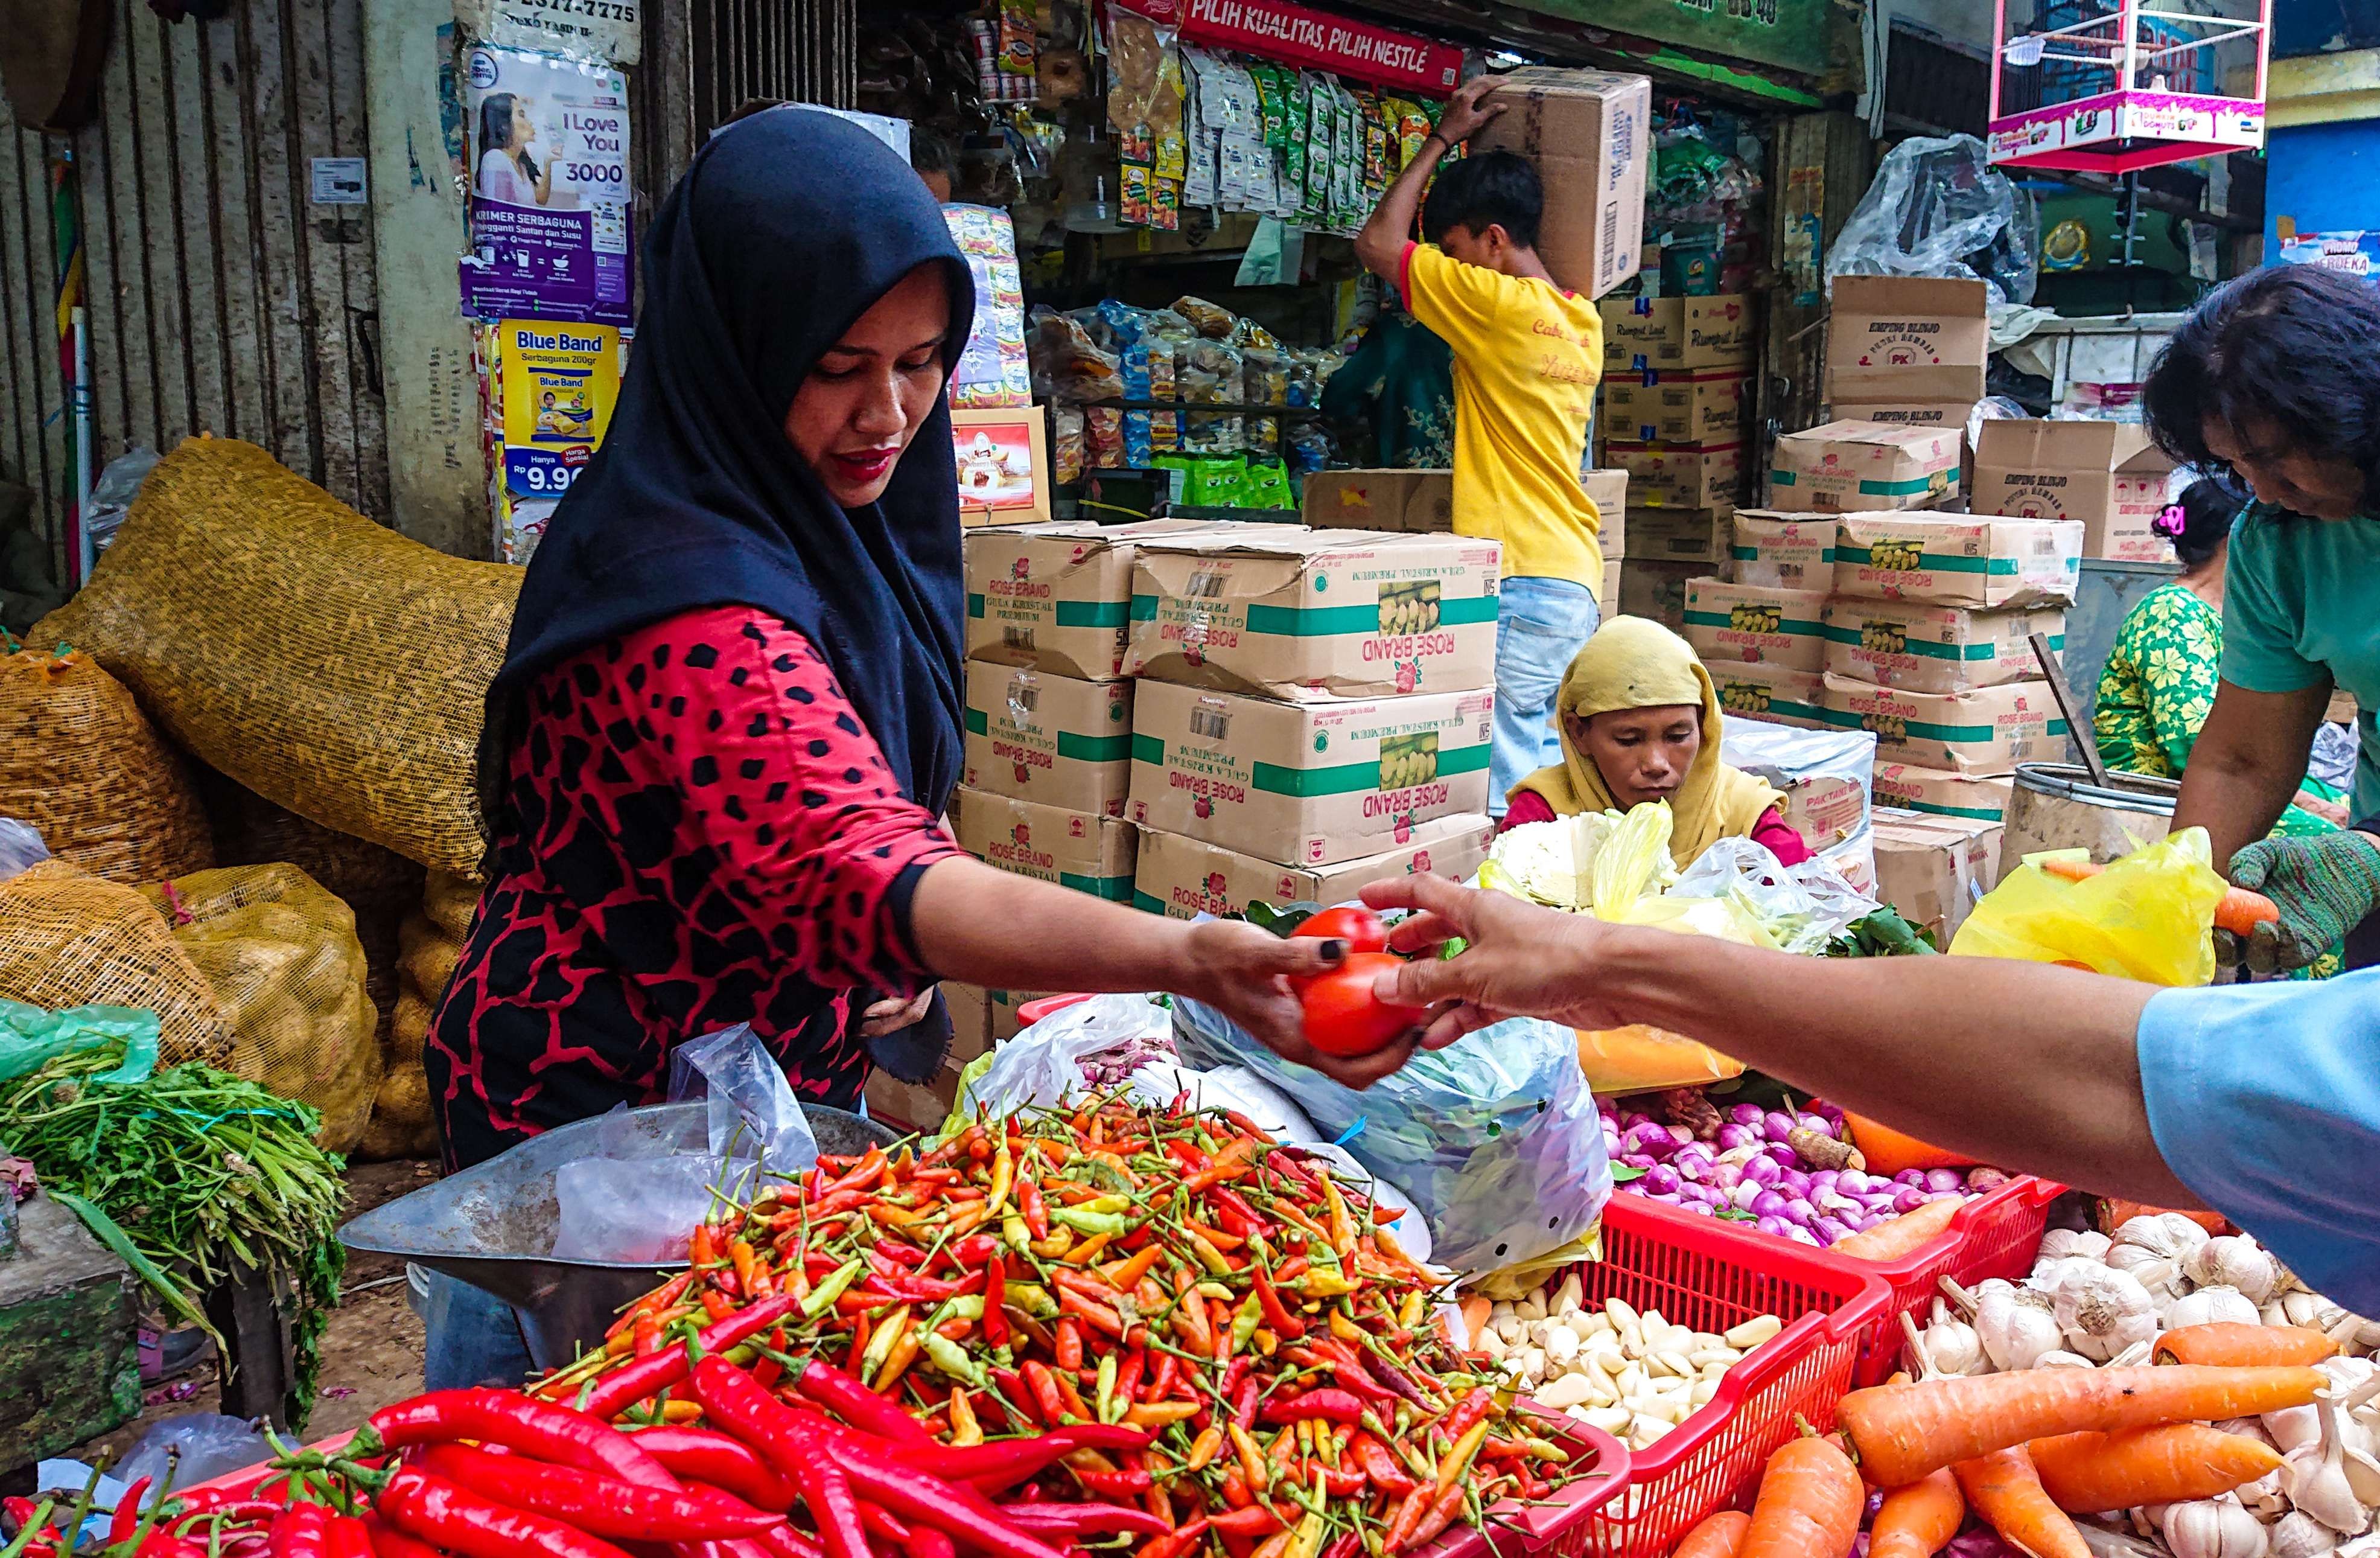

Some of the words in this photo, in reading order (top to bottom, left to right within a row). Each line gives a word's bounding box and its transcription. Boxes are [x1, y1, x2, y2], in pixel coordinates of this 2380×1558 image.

[1191, 0, 1241, 28] PILIH
[1243, 5, 1325, 52] KUALITAS,
[1328, 27, 1372, 59] PILIH
[1372, 40, 1430, 73] NESTLÉ
[563, 113, 569, 130] I
[573, 113, 619, 132] Love
[582, 134, 619, 152] You
[566, 162, 622, 183] 3000
[476, 211, 514, 223] KRIMER
[517, 213, 582, 230] SERBAGUNA
[476, 223, 514, 232] ngganti
[516, 225, 542, 234] Santan
[545, 228, 560, 237] dan
[561, 230, 581, 240] Susu
[1869, 322, 1905, 333] EMPING
[518, 331, 556, 349] Blue
[559, 334, 602, 351] Band
[521, 353, 569, 364] Serbaguna
[572, 356, 596, 366] 200gr
[540, 377, 560, 386] Blue
[561, 378, 582, 387] Band
[1872, 411, 1909, 421] EMPING
[531, 456, 556, 465] Hanya
[565, 455, 589, 463] Spesial
[1859, 569, 1896, 583] BRAND
[1899, 572, 1932, 587] ROSE
[990, 580, 1014, 595] ROSE
[1015, 583, 1050, 598] BRAND
[1416, 633, 1455, 656] ROSE
[1717, 631, 1755, 644] BRAND
[1760, 635, 1792, 648] ROSE
[1362, 636, 1412, 661] BRAND
[1850, 698, 1878, 713] ROSE
[1880, 701, 1917, 718] BRAND
[1998, 714, 2017, 724] ROSE
[2020, 712, 2043, 723] BRAND
[993, 741, 1023, 761] BRAND
[1026, 750, 1052, 769] ROSE
[1180, 745, 1235, 766] PREMIUM
[1166, 755, 1212, 774] KRISTAL
[1169, 771, 1208, 794] BRAND
[1217, 766, 1249, 782] GULA
[1212, 782, 1244, 803] ROSE
[1414, 784, 1448, 808] ROSE
[1885, 782, 1924, 798] BRAND
[1363, 788, 1411, 818] BRAND
[1807, 796, 1826, 807] PAK
[990, 842, 1016, 860] ROSE
[1017, 848, 1053, 869] BRAND
[1014, 865, 1057, 883] KRISTAL
[1173, 886, 1206, 912] ROSE
[1209, 898, 1246, 918] BRA
[1168, 905, 1189, 919] GUL
